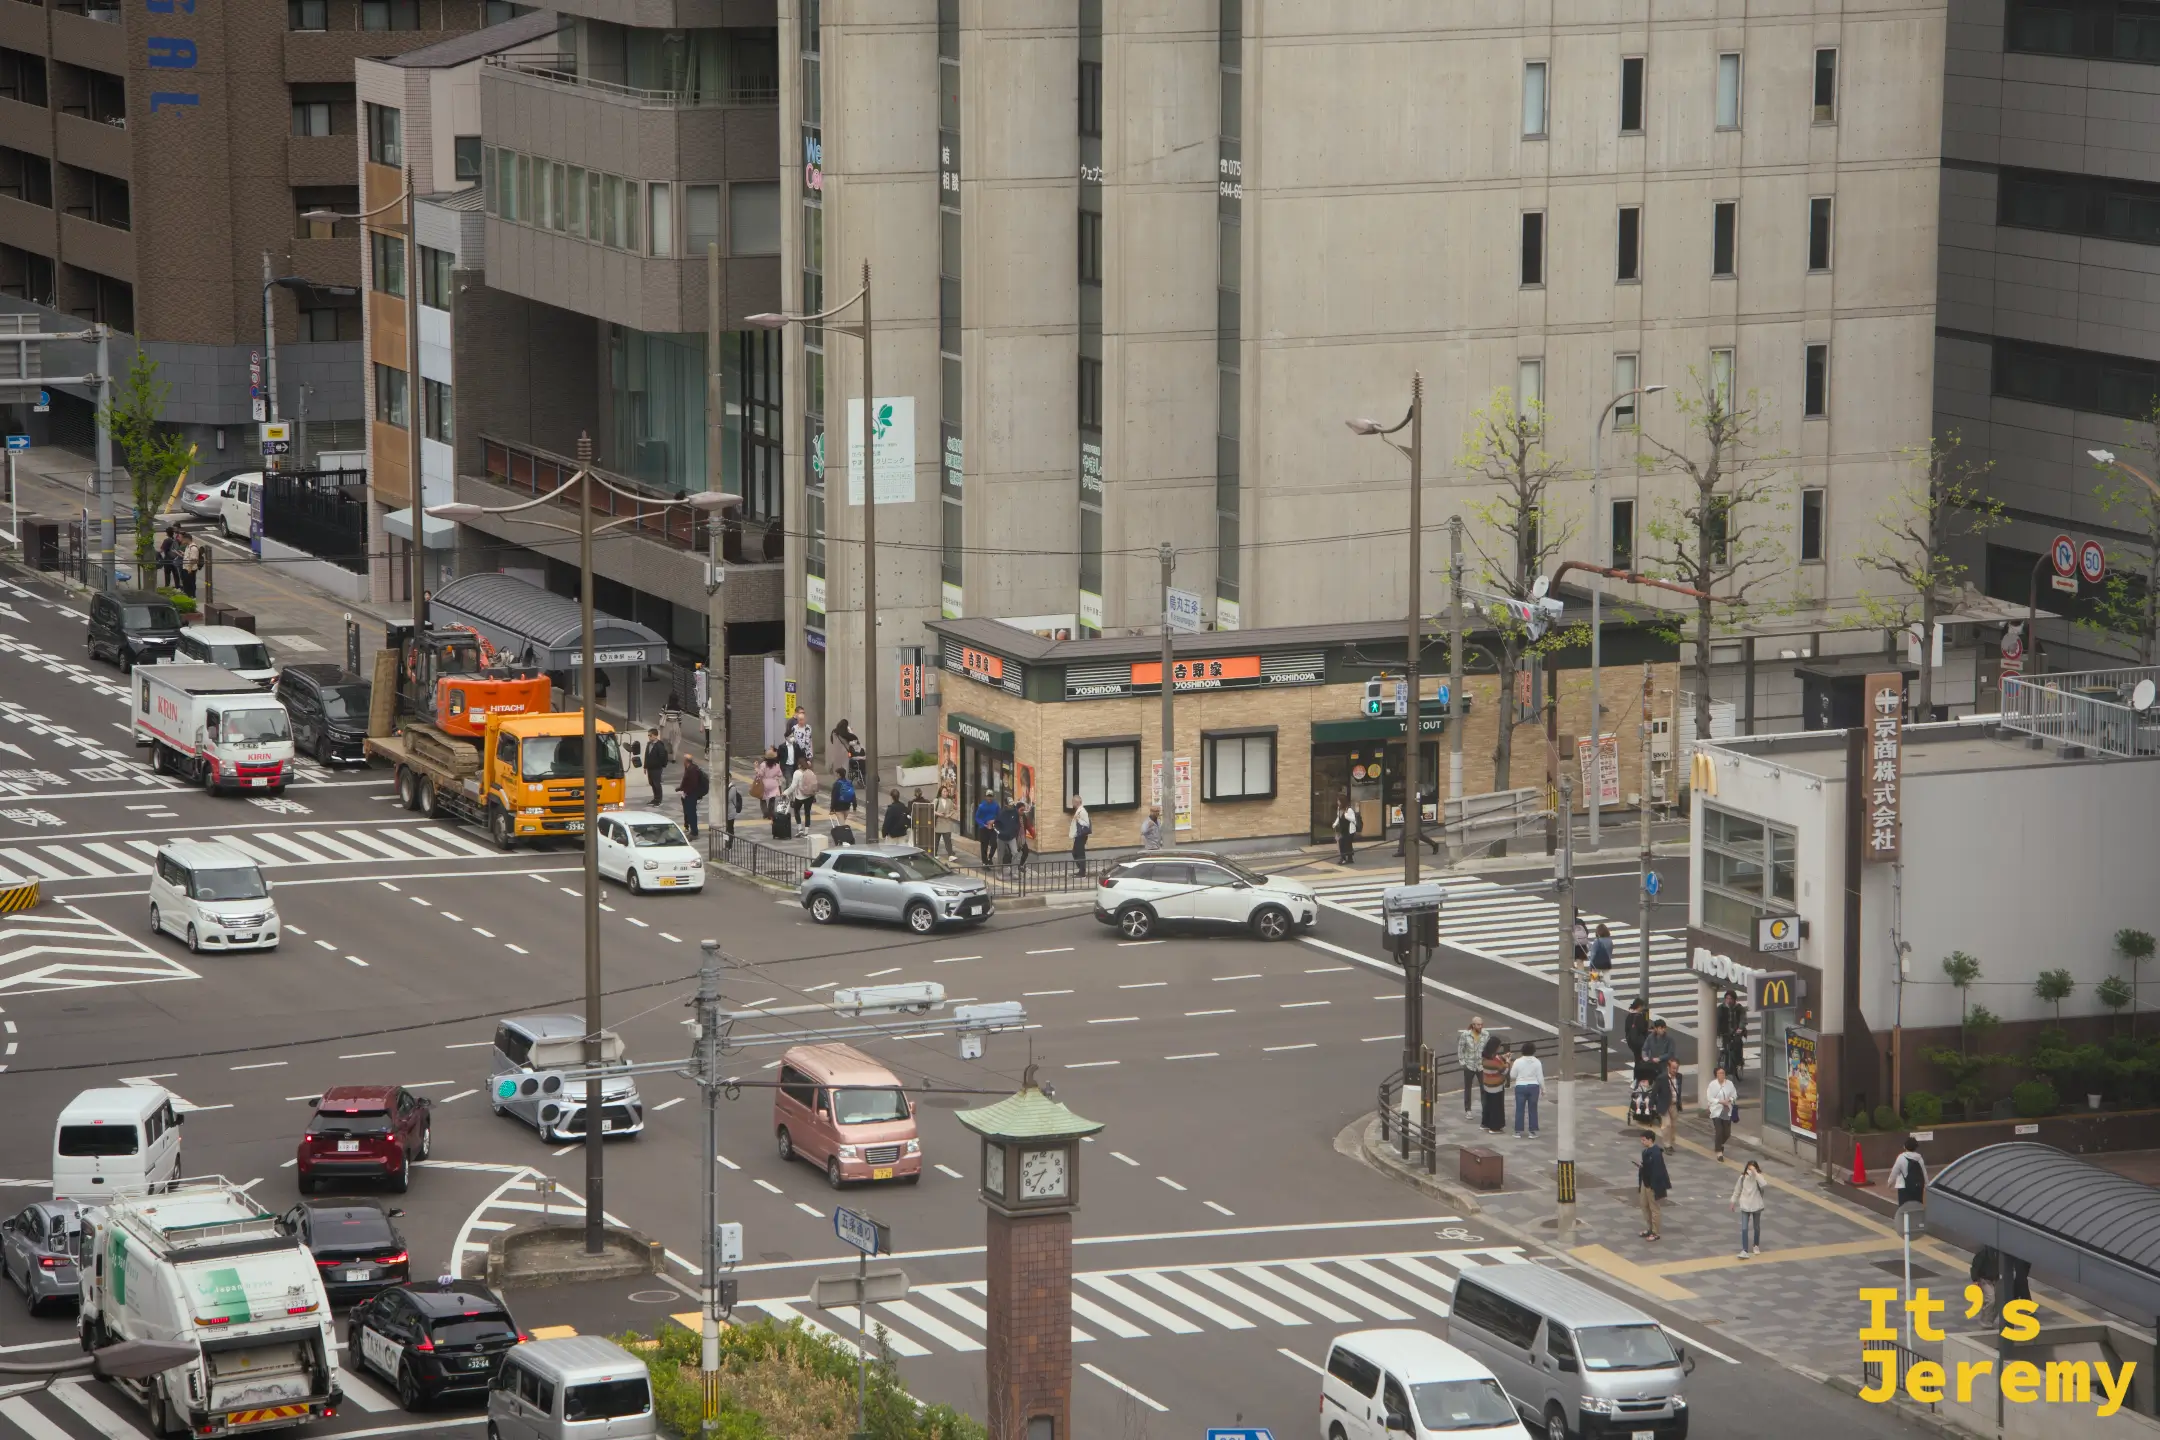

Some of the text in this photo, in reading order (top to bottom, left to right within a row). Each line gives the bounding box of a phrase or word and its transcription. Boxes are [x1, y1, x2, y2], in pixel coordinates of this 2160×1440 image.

[2086, 552, 2099, 571] 50
[1169, 595, 1198, 616] 烏丸五条
[637, 650, 643, 660] 2
[1174, 661, 1222, 679] 吉野家
[158, 696, 178, 722] KIRIN
[490, 703, 525, 712] HITACHI
[958, 722, 990, 743] YOSHINOYA
[1423, 720, 1441, 730] OUT
[248, 753, 272, 761] KIRIN
